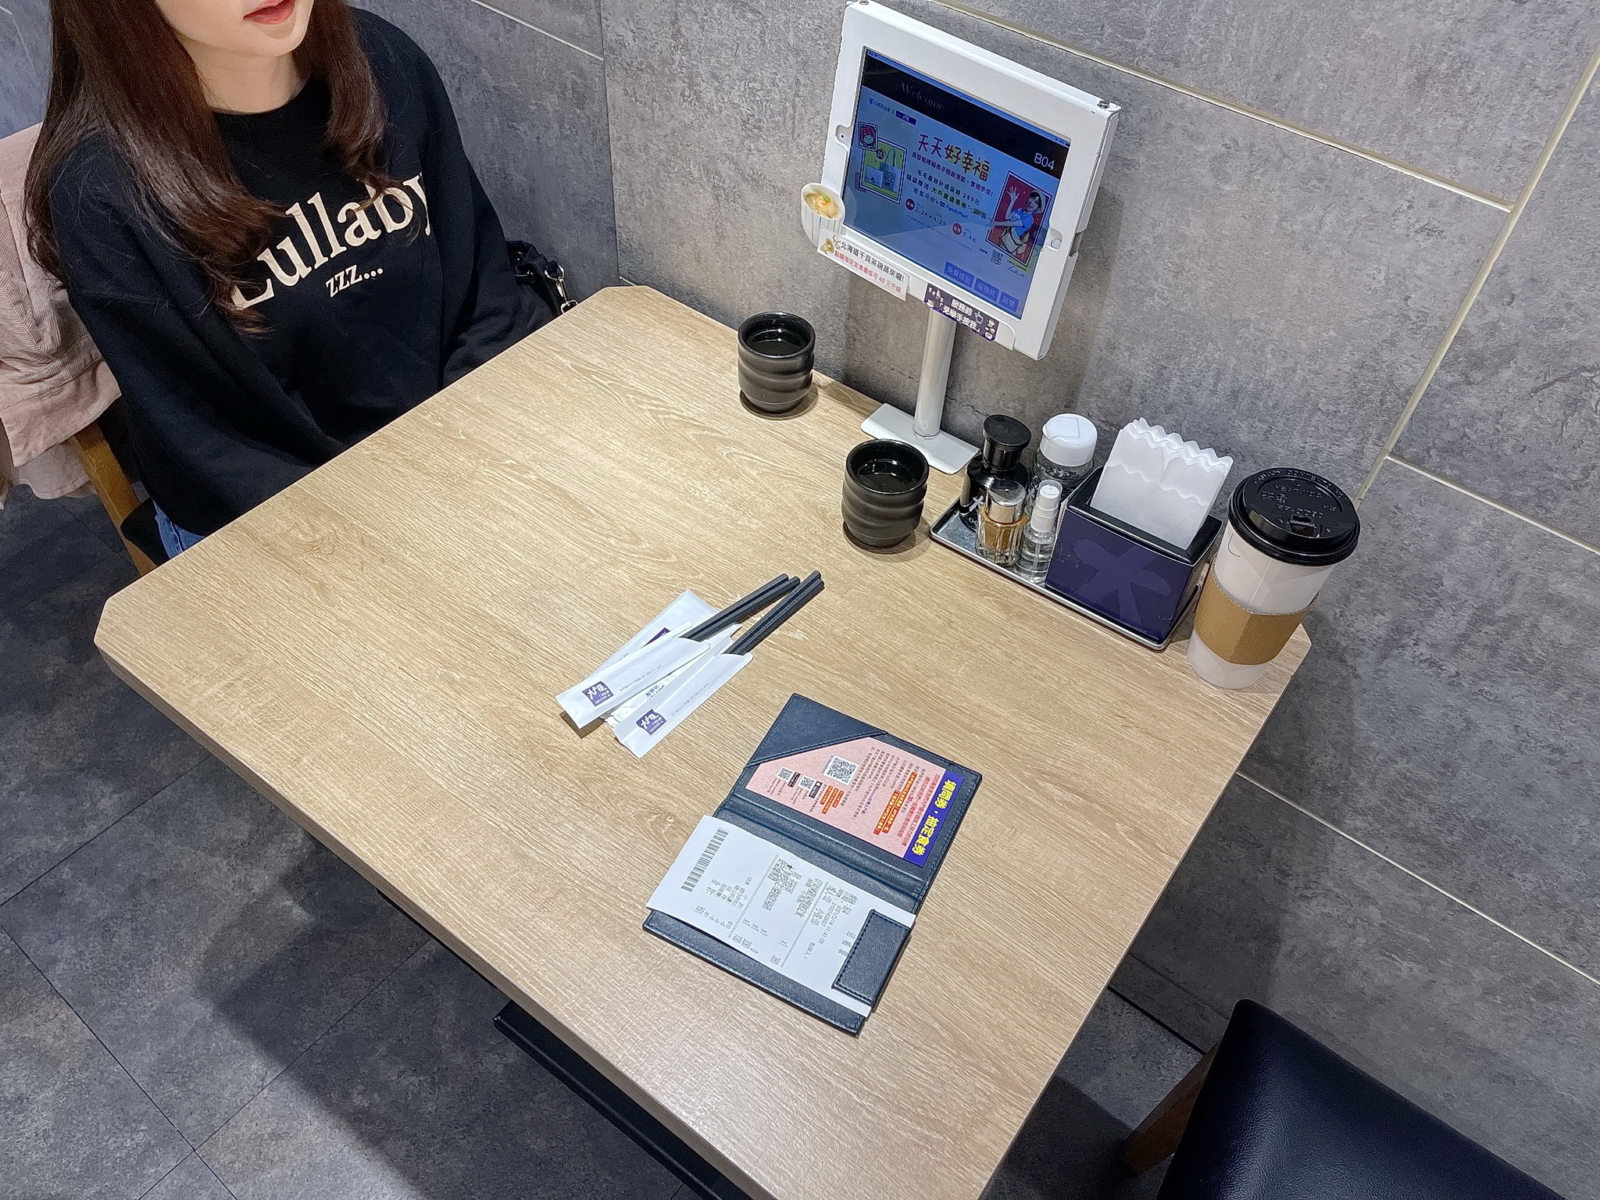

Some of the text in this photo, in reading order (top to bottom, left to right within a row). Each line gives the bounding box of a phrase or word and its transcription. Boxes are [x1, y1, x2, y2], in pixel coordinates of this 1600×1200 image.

[919, 134, 990, 182] 天天好幸福
[1034, 152, 1055, 171] B04
[230, 171, 431, 311] Lullaby
